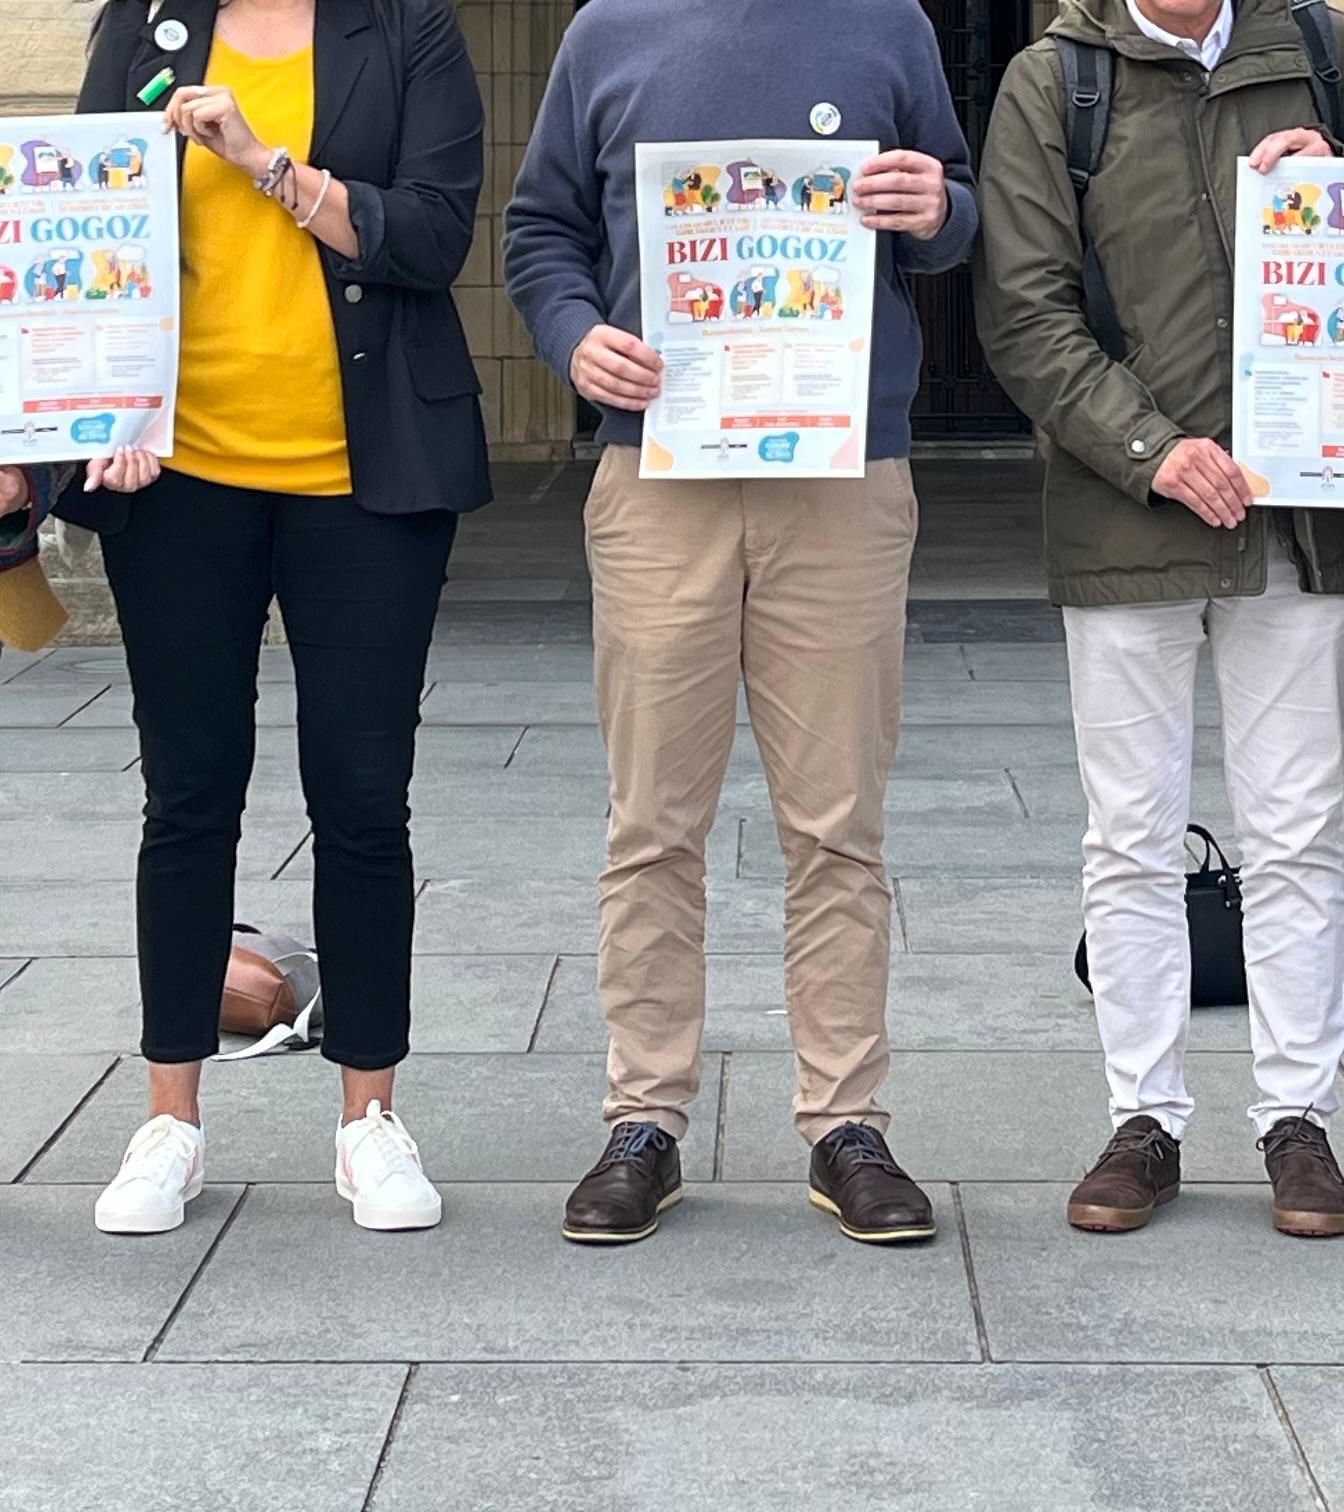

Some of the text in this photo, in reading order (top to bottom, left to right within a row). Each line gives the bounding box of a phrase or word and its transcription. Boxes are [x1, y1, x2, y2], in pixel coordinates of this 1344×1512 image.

[30, 214, 151, 243] GOGOZ
[666, 234, 847, 265] BIZI GOGOZ
[1262, 261, 1327, 286] BIZI
